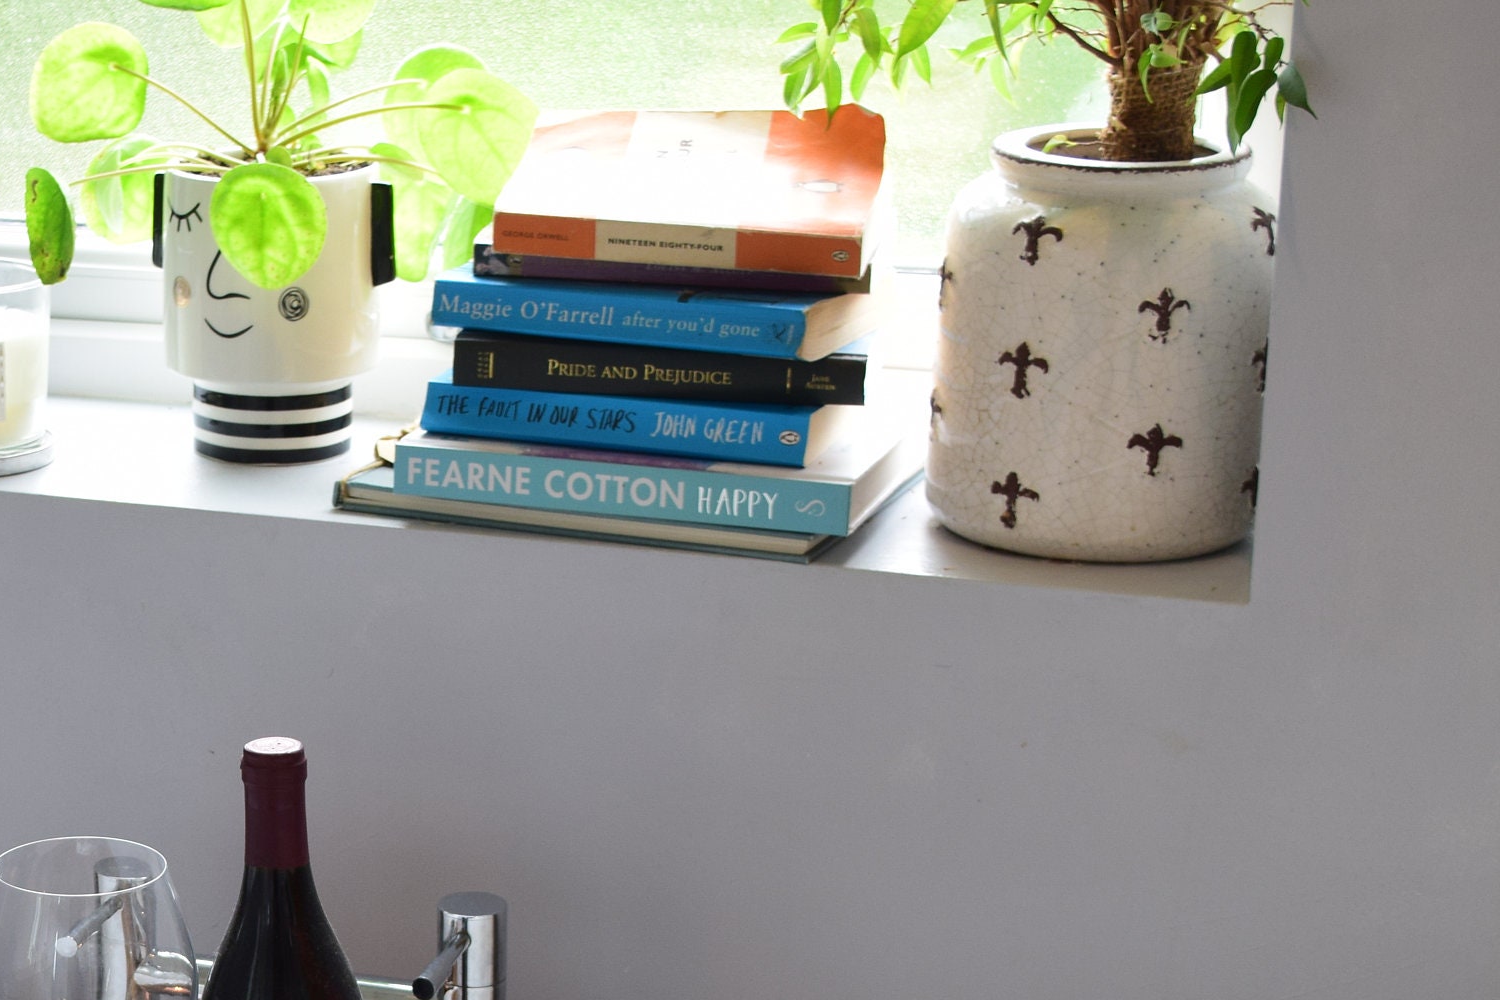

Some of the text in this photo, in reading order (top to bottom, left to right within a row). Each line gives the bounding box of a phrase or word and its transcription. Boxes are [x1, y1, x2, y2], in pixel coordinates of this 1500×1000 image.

[502, 229, 534, 240] GEORGE
[608, 237, 724, 252] NINETEEN EIGHTY-FOUR
[439, 293, 760, 338] Maggie O'Farrell after you'd gone
[601, 365, 637, 380] AND
[643, 363, 732, 385] PREJUDICE
[438, 395, 637, 433] THE FAULT IN OUR STARS
[650, 411, 765, 446] JOHN GREEN
[406, 456, 685, 510] FEARNE COTTON
[697, 485, 779, 520] HAPPY
